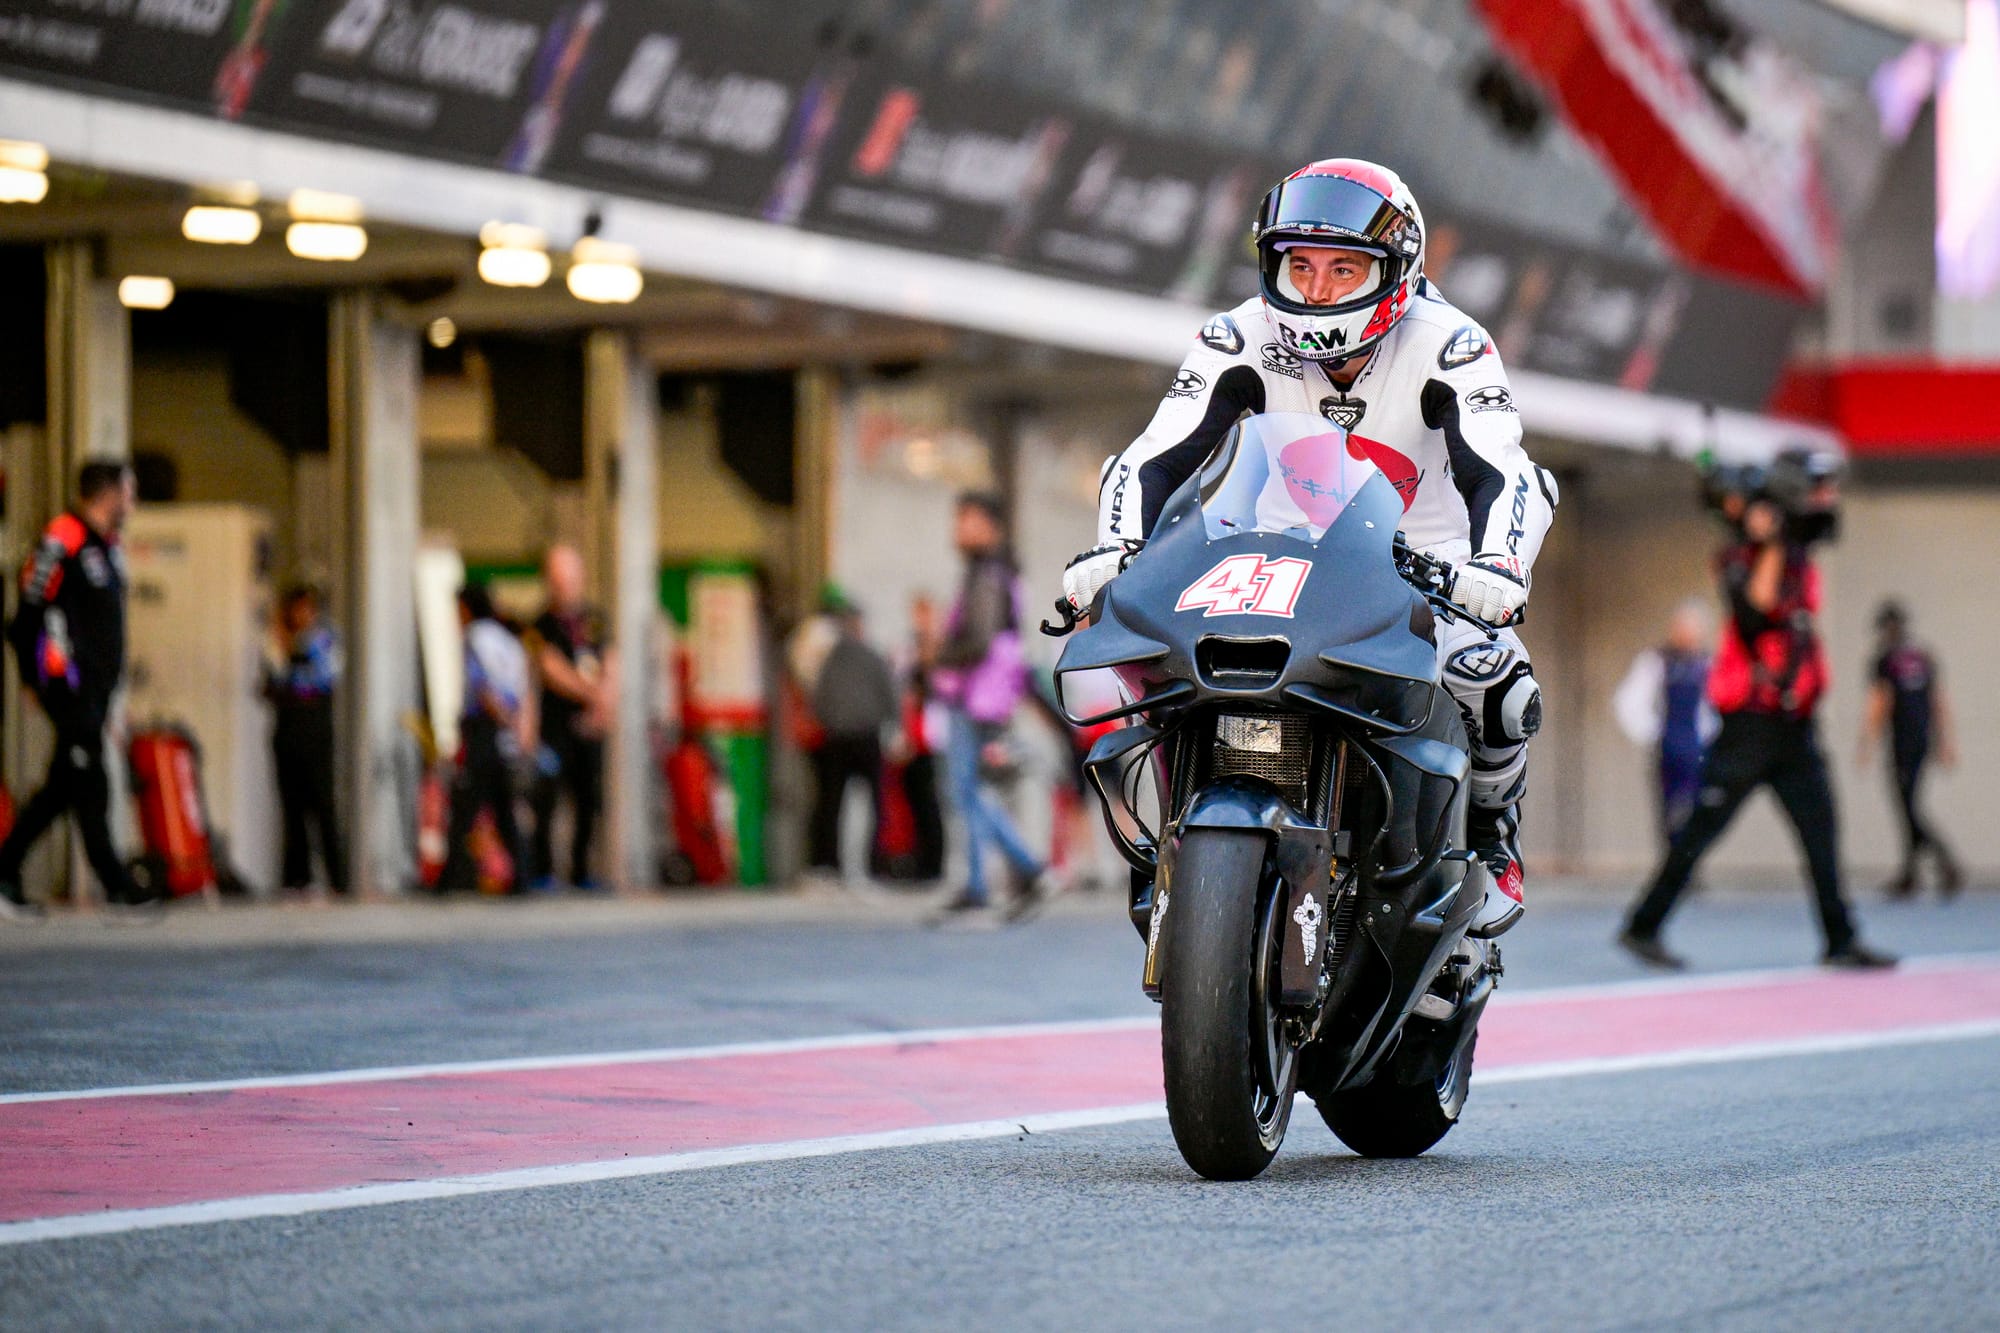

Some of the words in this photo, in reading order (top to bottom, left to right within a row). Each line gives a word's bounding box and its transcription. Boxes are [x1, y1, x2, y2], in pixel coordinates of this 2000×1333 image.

[1278, 322, 1347, 351] RAW
[1109, 463, 1131, 535] IXON
[1174, 553, 1313, 619] 41
